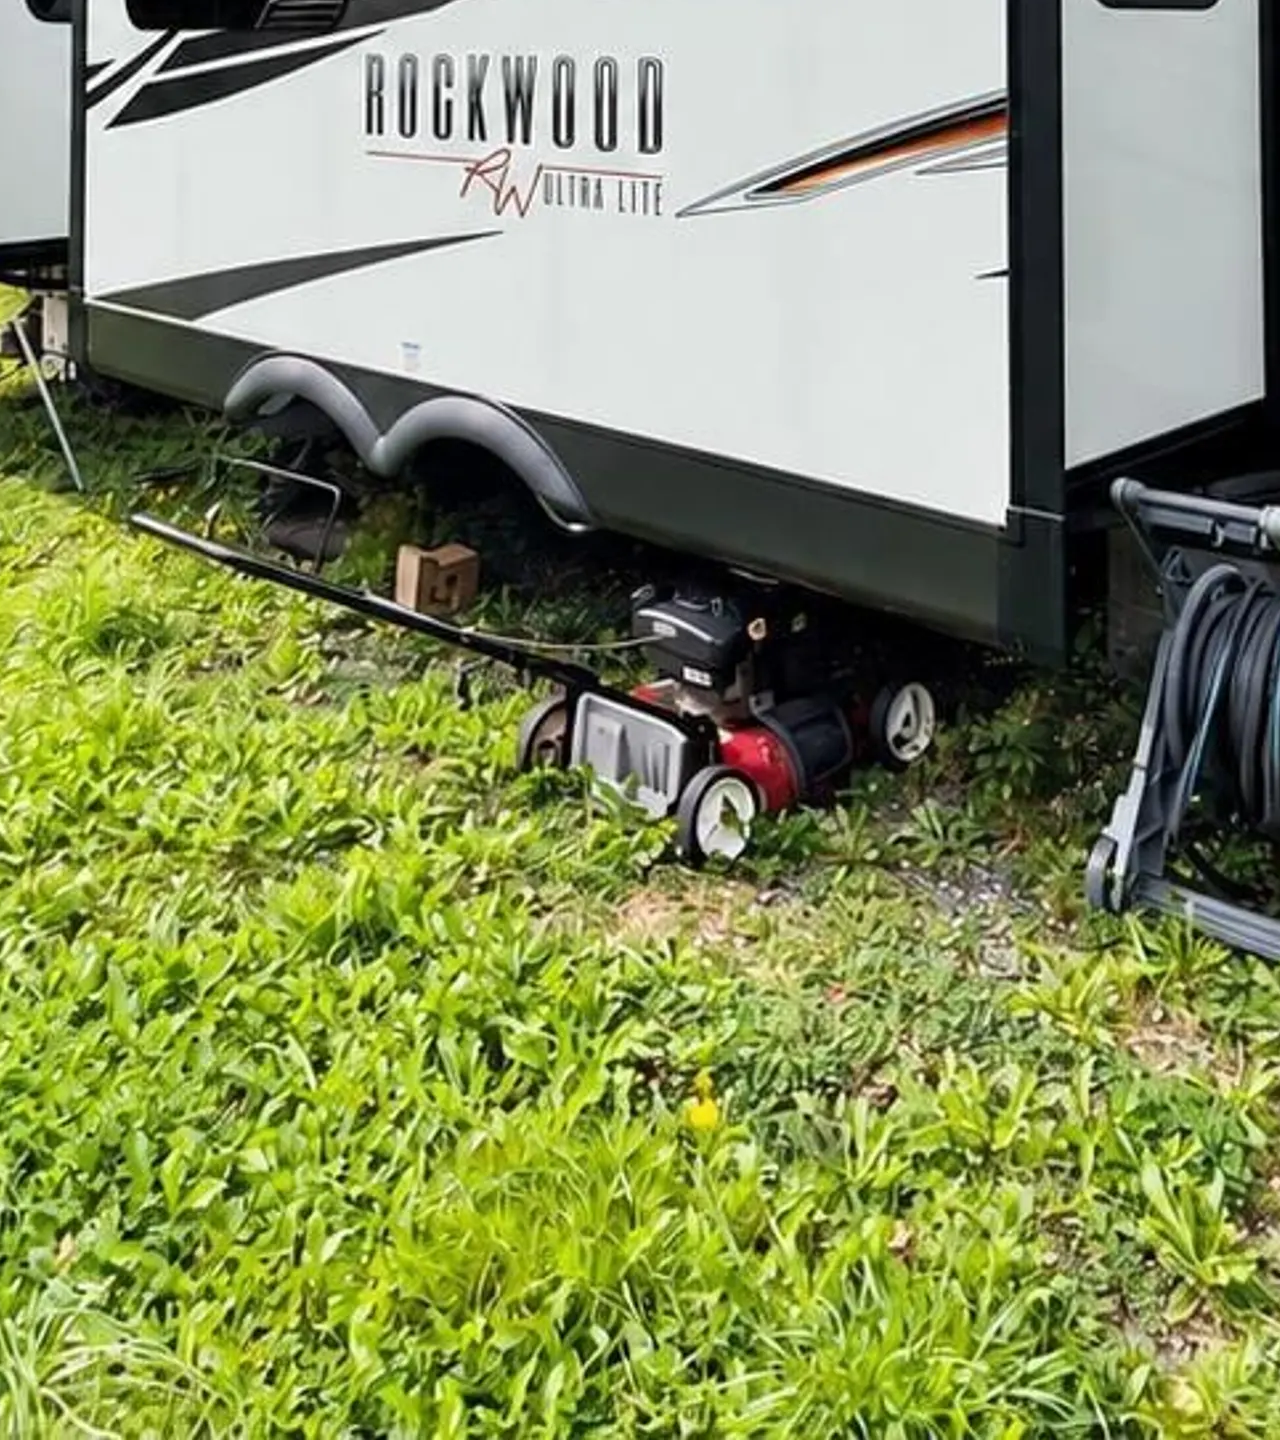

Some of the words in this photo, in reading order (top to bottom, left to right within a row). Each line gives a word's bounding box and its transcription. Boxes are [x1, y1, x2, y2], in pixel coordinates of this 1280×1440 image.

[365, 53, 664, 155] ROCKWOOD
[543, 171, 605, 211] ULTRA
[618, 178, 664, 217] LITE
